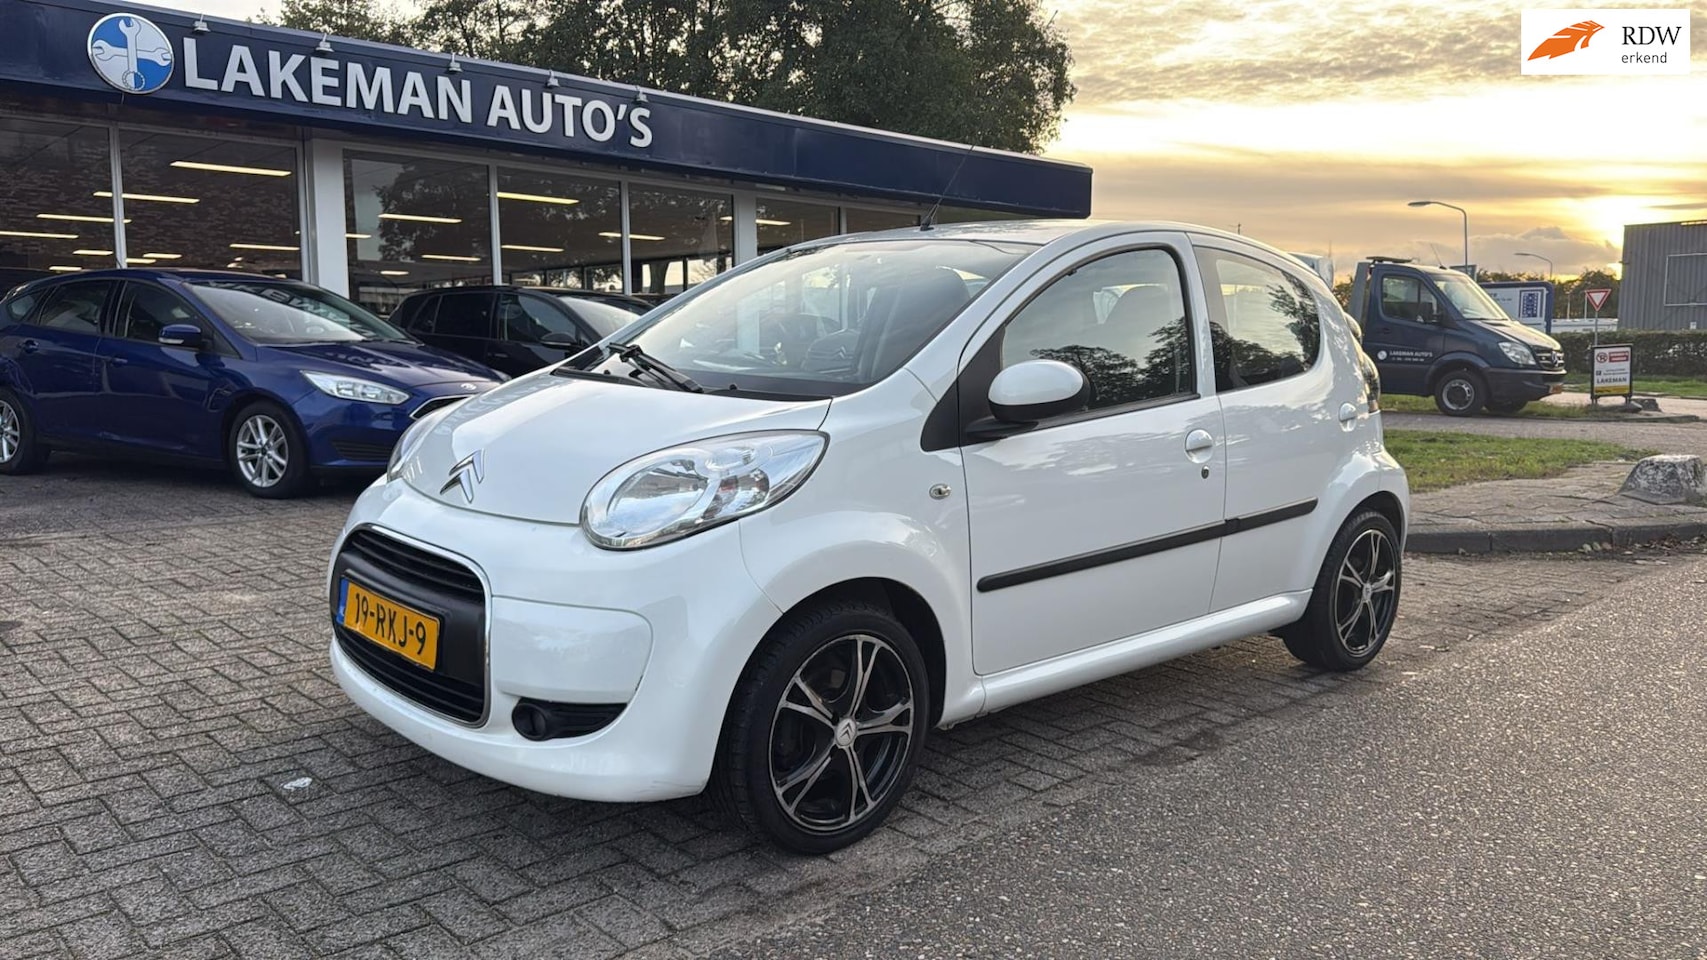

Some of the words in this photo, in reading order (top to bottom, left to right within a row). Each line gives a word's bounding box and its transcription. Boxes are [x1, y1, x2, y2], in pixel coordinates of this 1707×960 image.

[183, 37, 473, 123] LAKEMAN
[487, 85, 653, 148] AUTO'S
[355, 593, 426, 654] 19-RKJ-9
